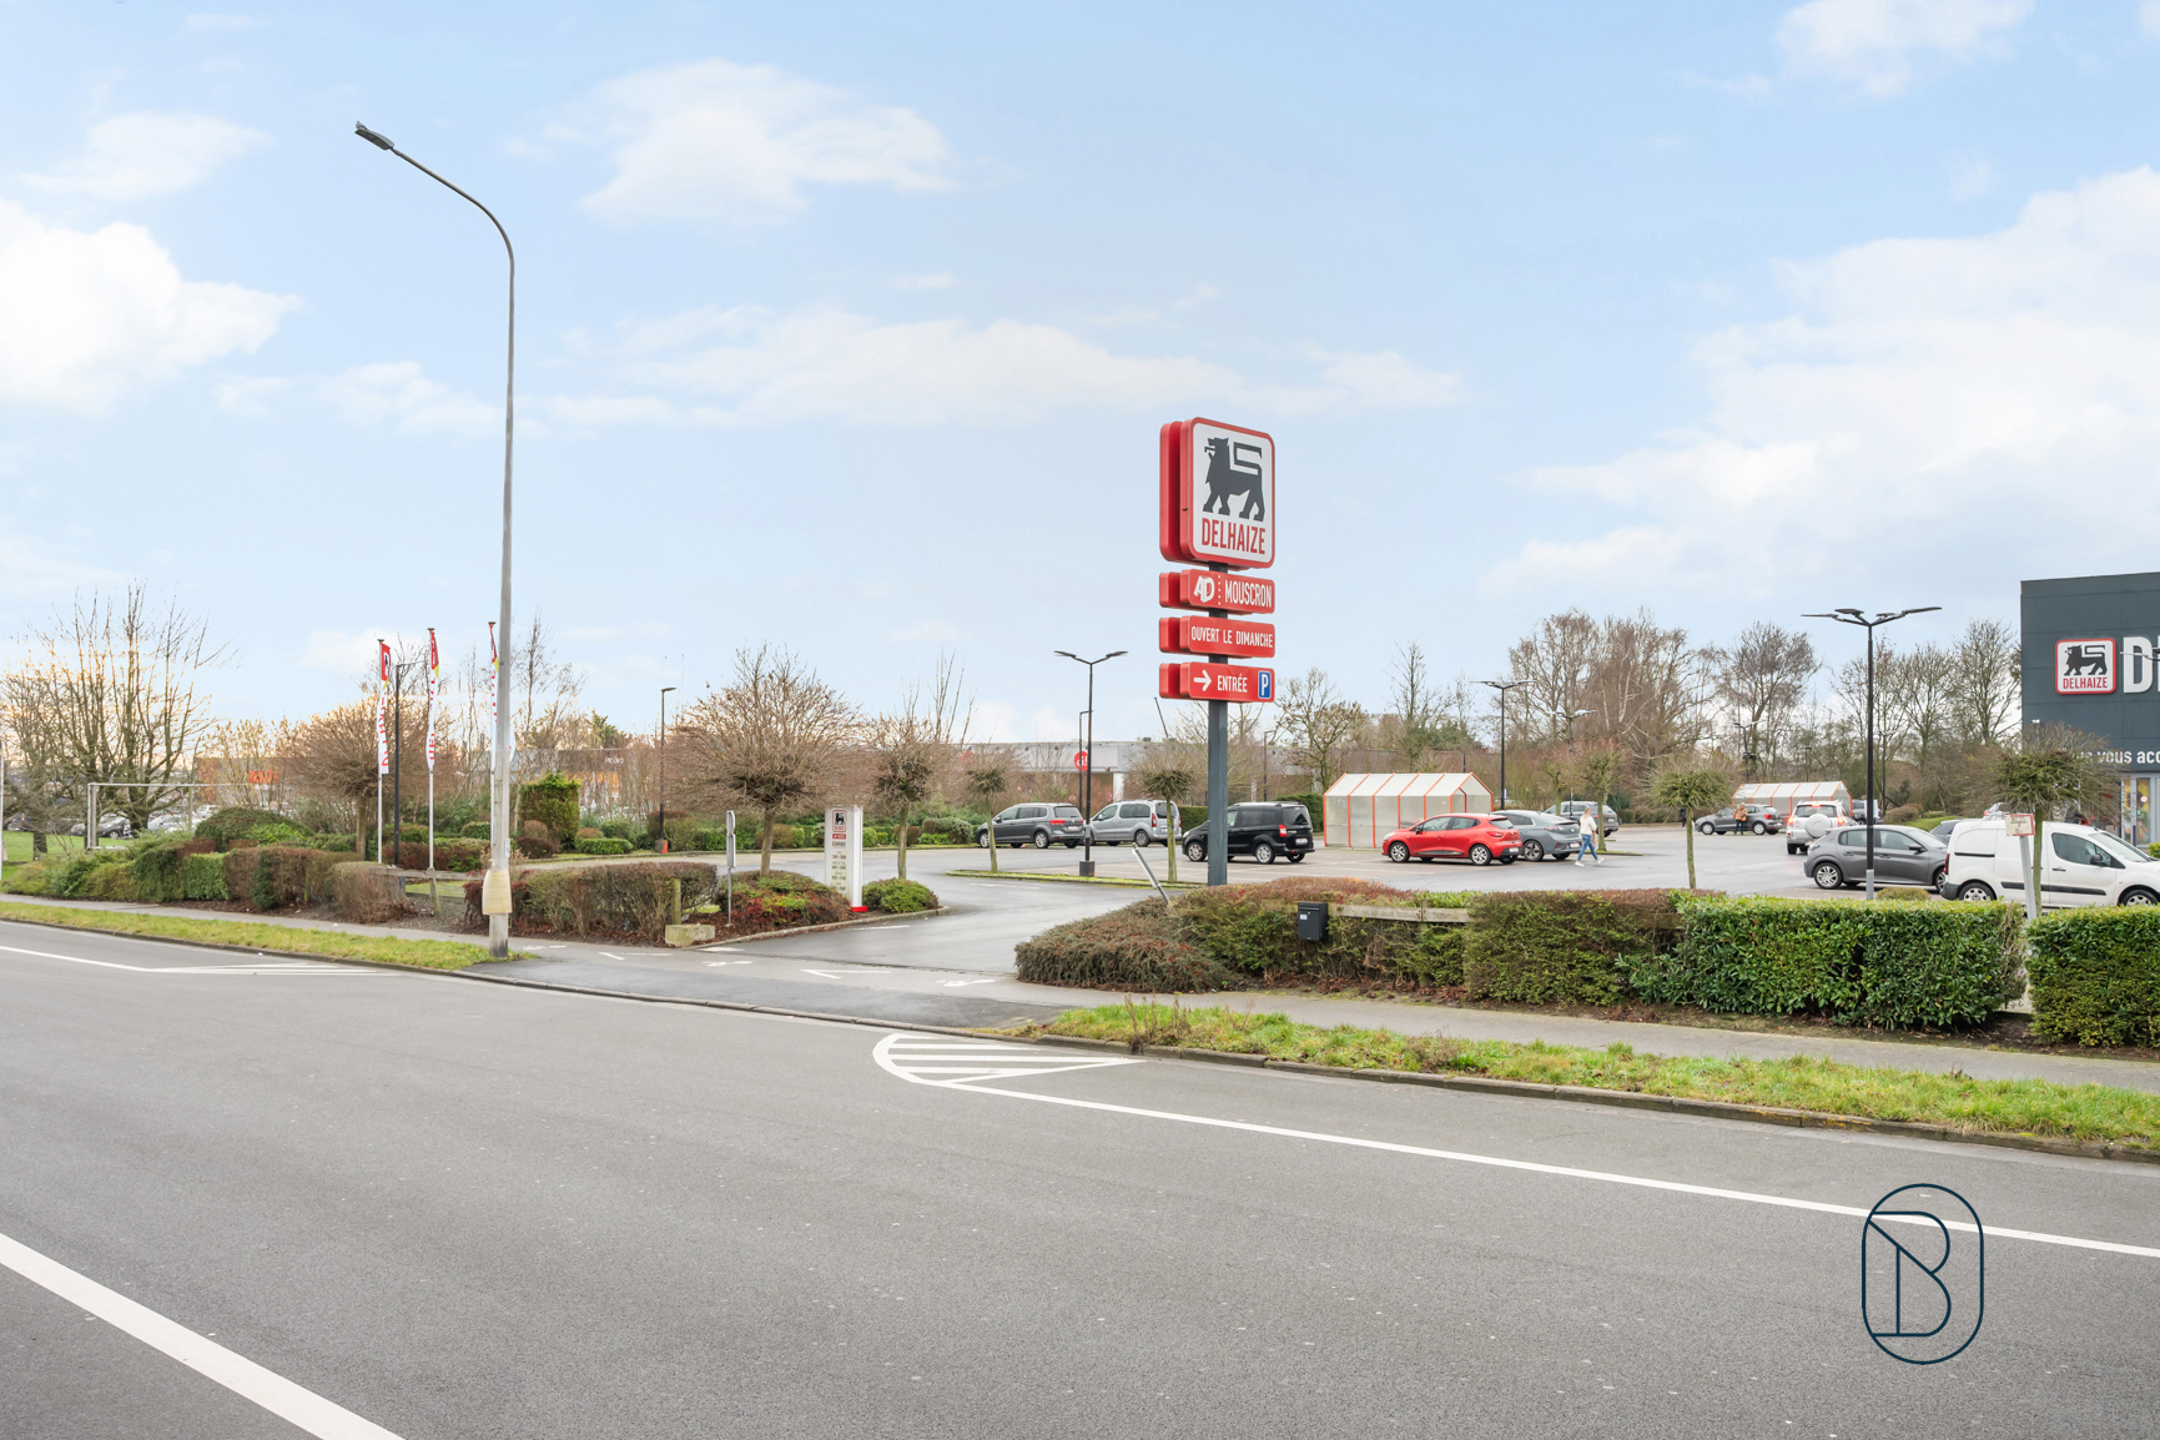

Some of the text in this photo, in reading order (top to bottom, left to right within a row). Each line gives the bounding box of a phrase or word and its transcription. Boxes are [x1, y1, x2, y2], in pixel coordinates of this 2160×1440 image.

[1202, 517, 1266, 555] DELHAIZE
[1193, 575, 1272, 608] AD MOUSCRON
[1191, 626, 1273, 648] OUVERT LE DIMANCHE
[2123, 636, 2160, 693] D
[1217, 673, 1269, 696] ENTRÉE P
[2063, 676, 2108, 689] DELHAIZE
[2097, 751, 2132, 764] vous
